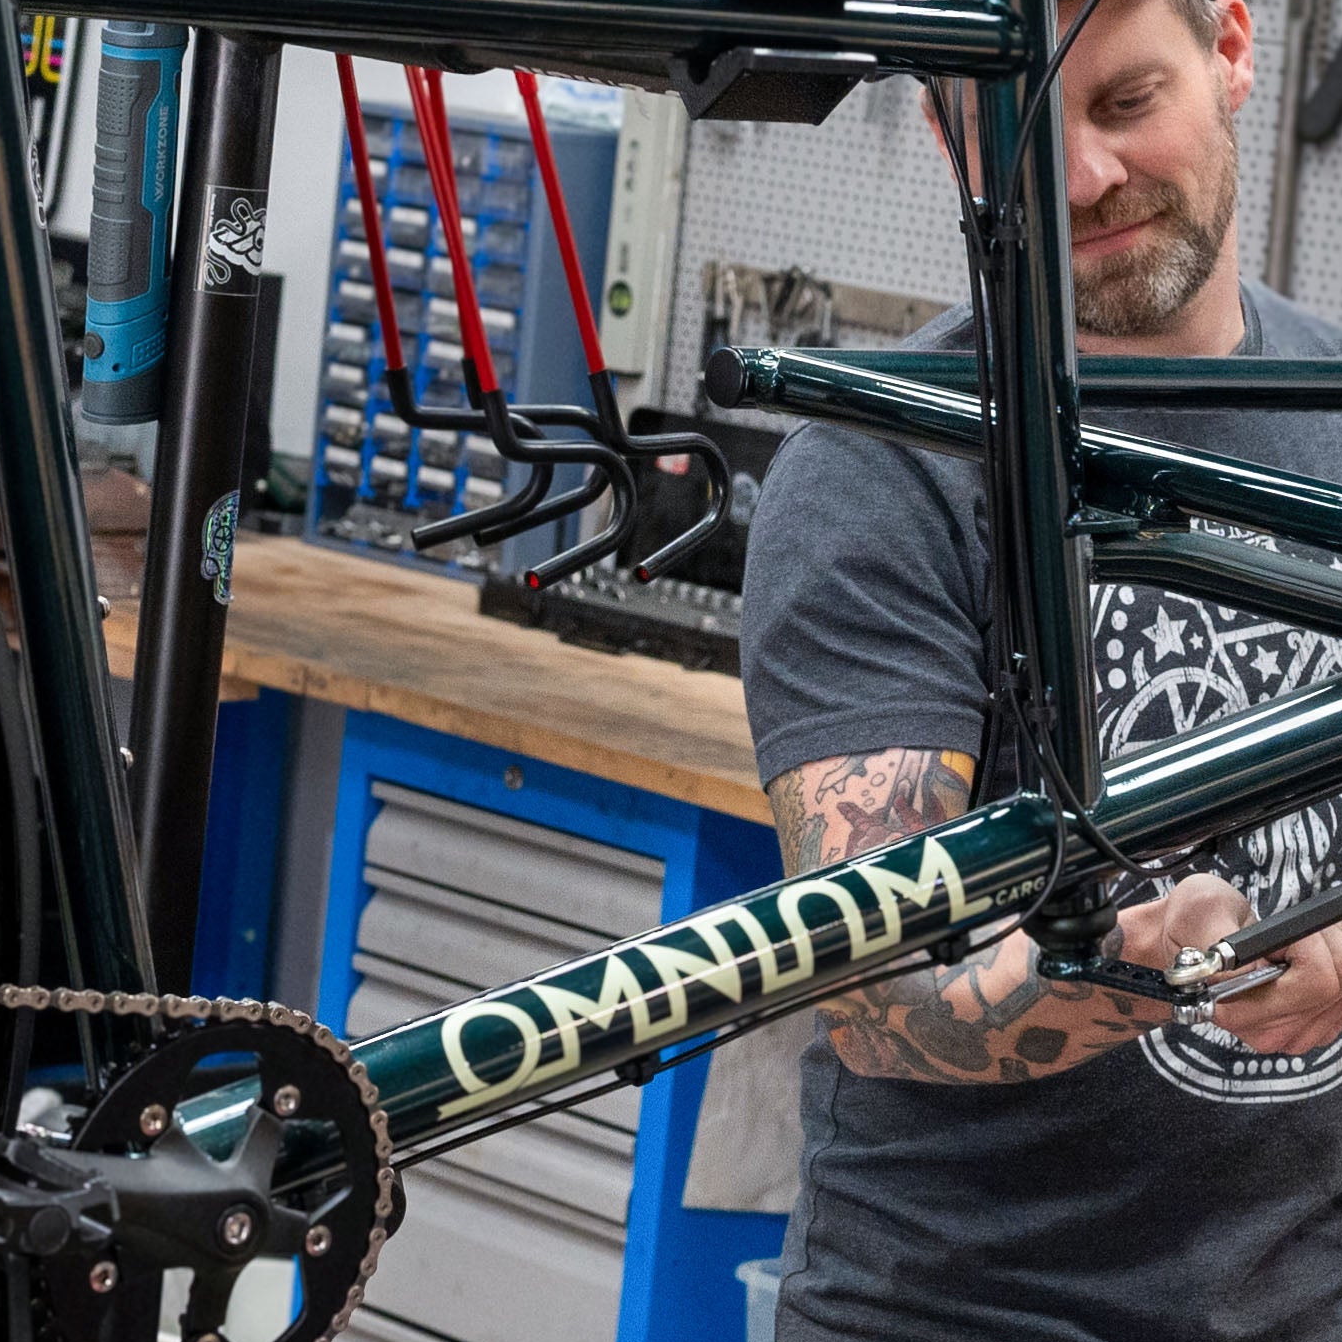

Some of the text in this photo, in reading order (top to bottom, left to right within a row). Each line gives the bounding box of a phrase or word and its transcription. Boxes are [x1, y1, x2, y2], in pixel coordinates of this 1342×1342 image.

[153, 105, 171, 203] WORKZONE
[438, 839, 1050, 1117] OMNIUM CARG
